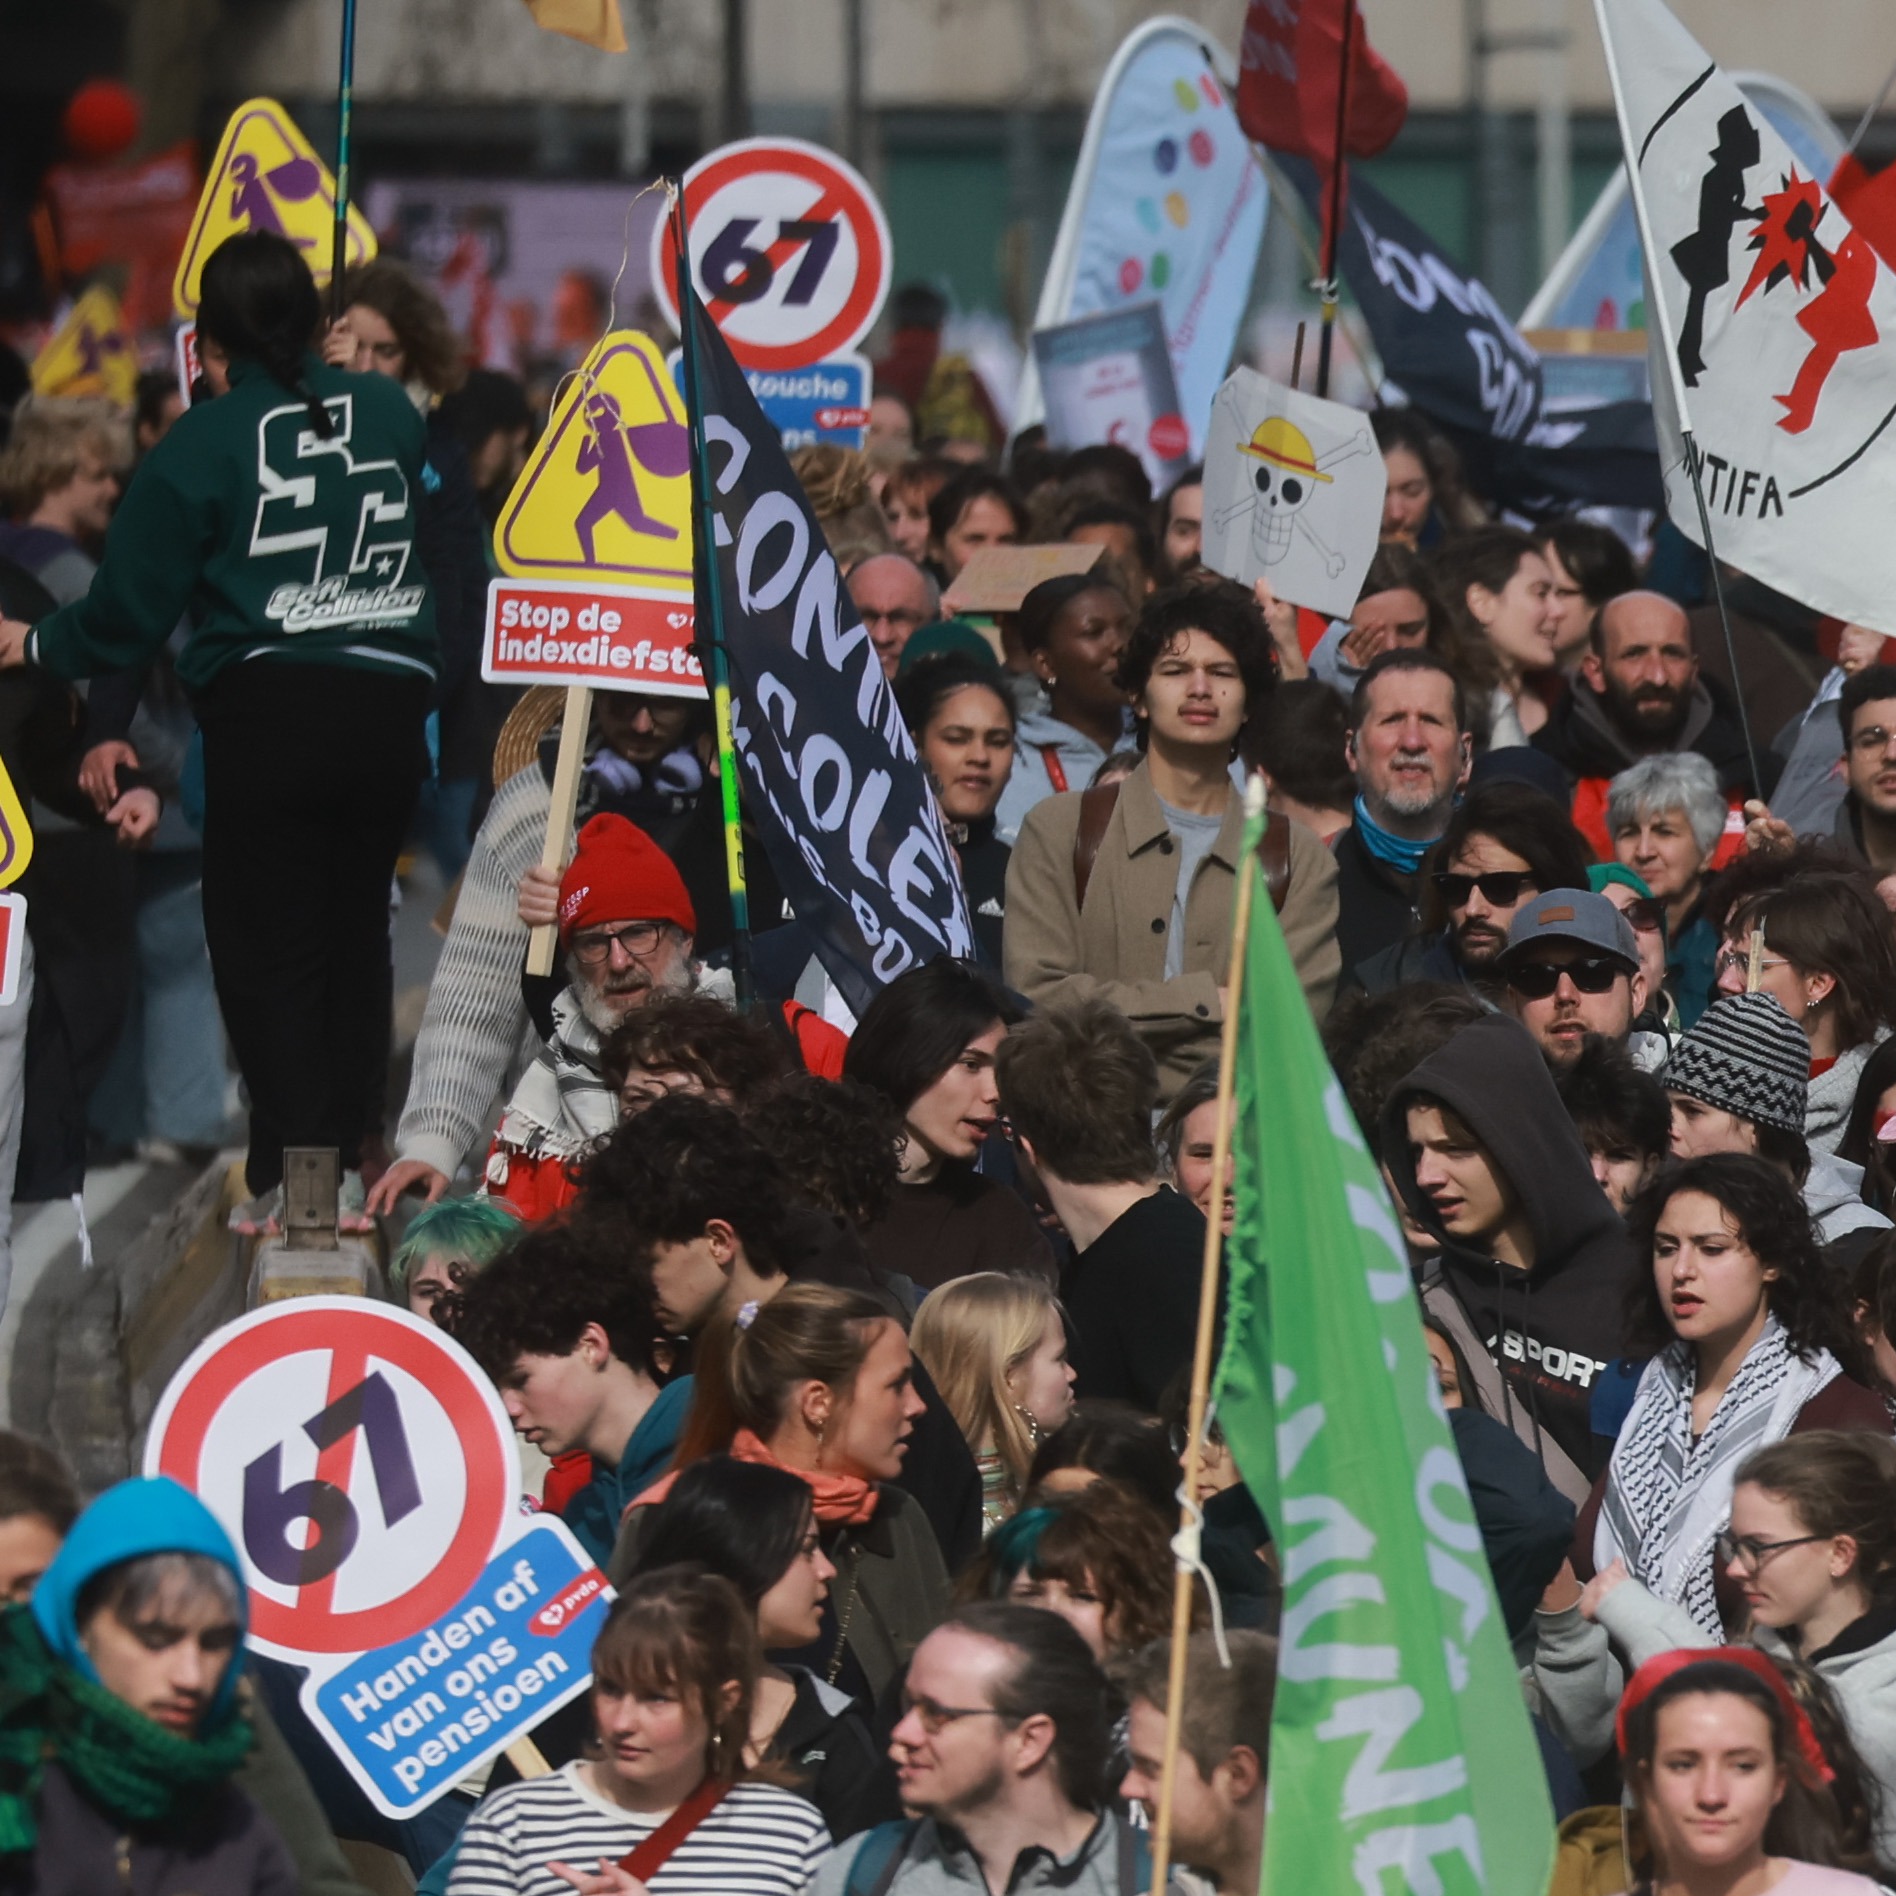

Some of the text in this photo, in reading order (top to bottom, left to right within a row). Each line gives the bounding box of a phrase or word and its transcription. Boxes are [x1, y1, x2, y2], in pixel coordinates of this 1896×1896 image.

[700, 218, 840, 308] 67
[499, 598, 622, 637] Stop de
[241, 1370, 425, 1587] 67
[339, 1558, 540, 1724] Handen af
[563, 1578, 600, 1610] pvda
[366, 1636, 519, 1752] van ons
[391, 1650, 570, 1795] pensioen
